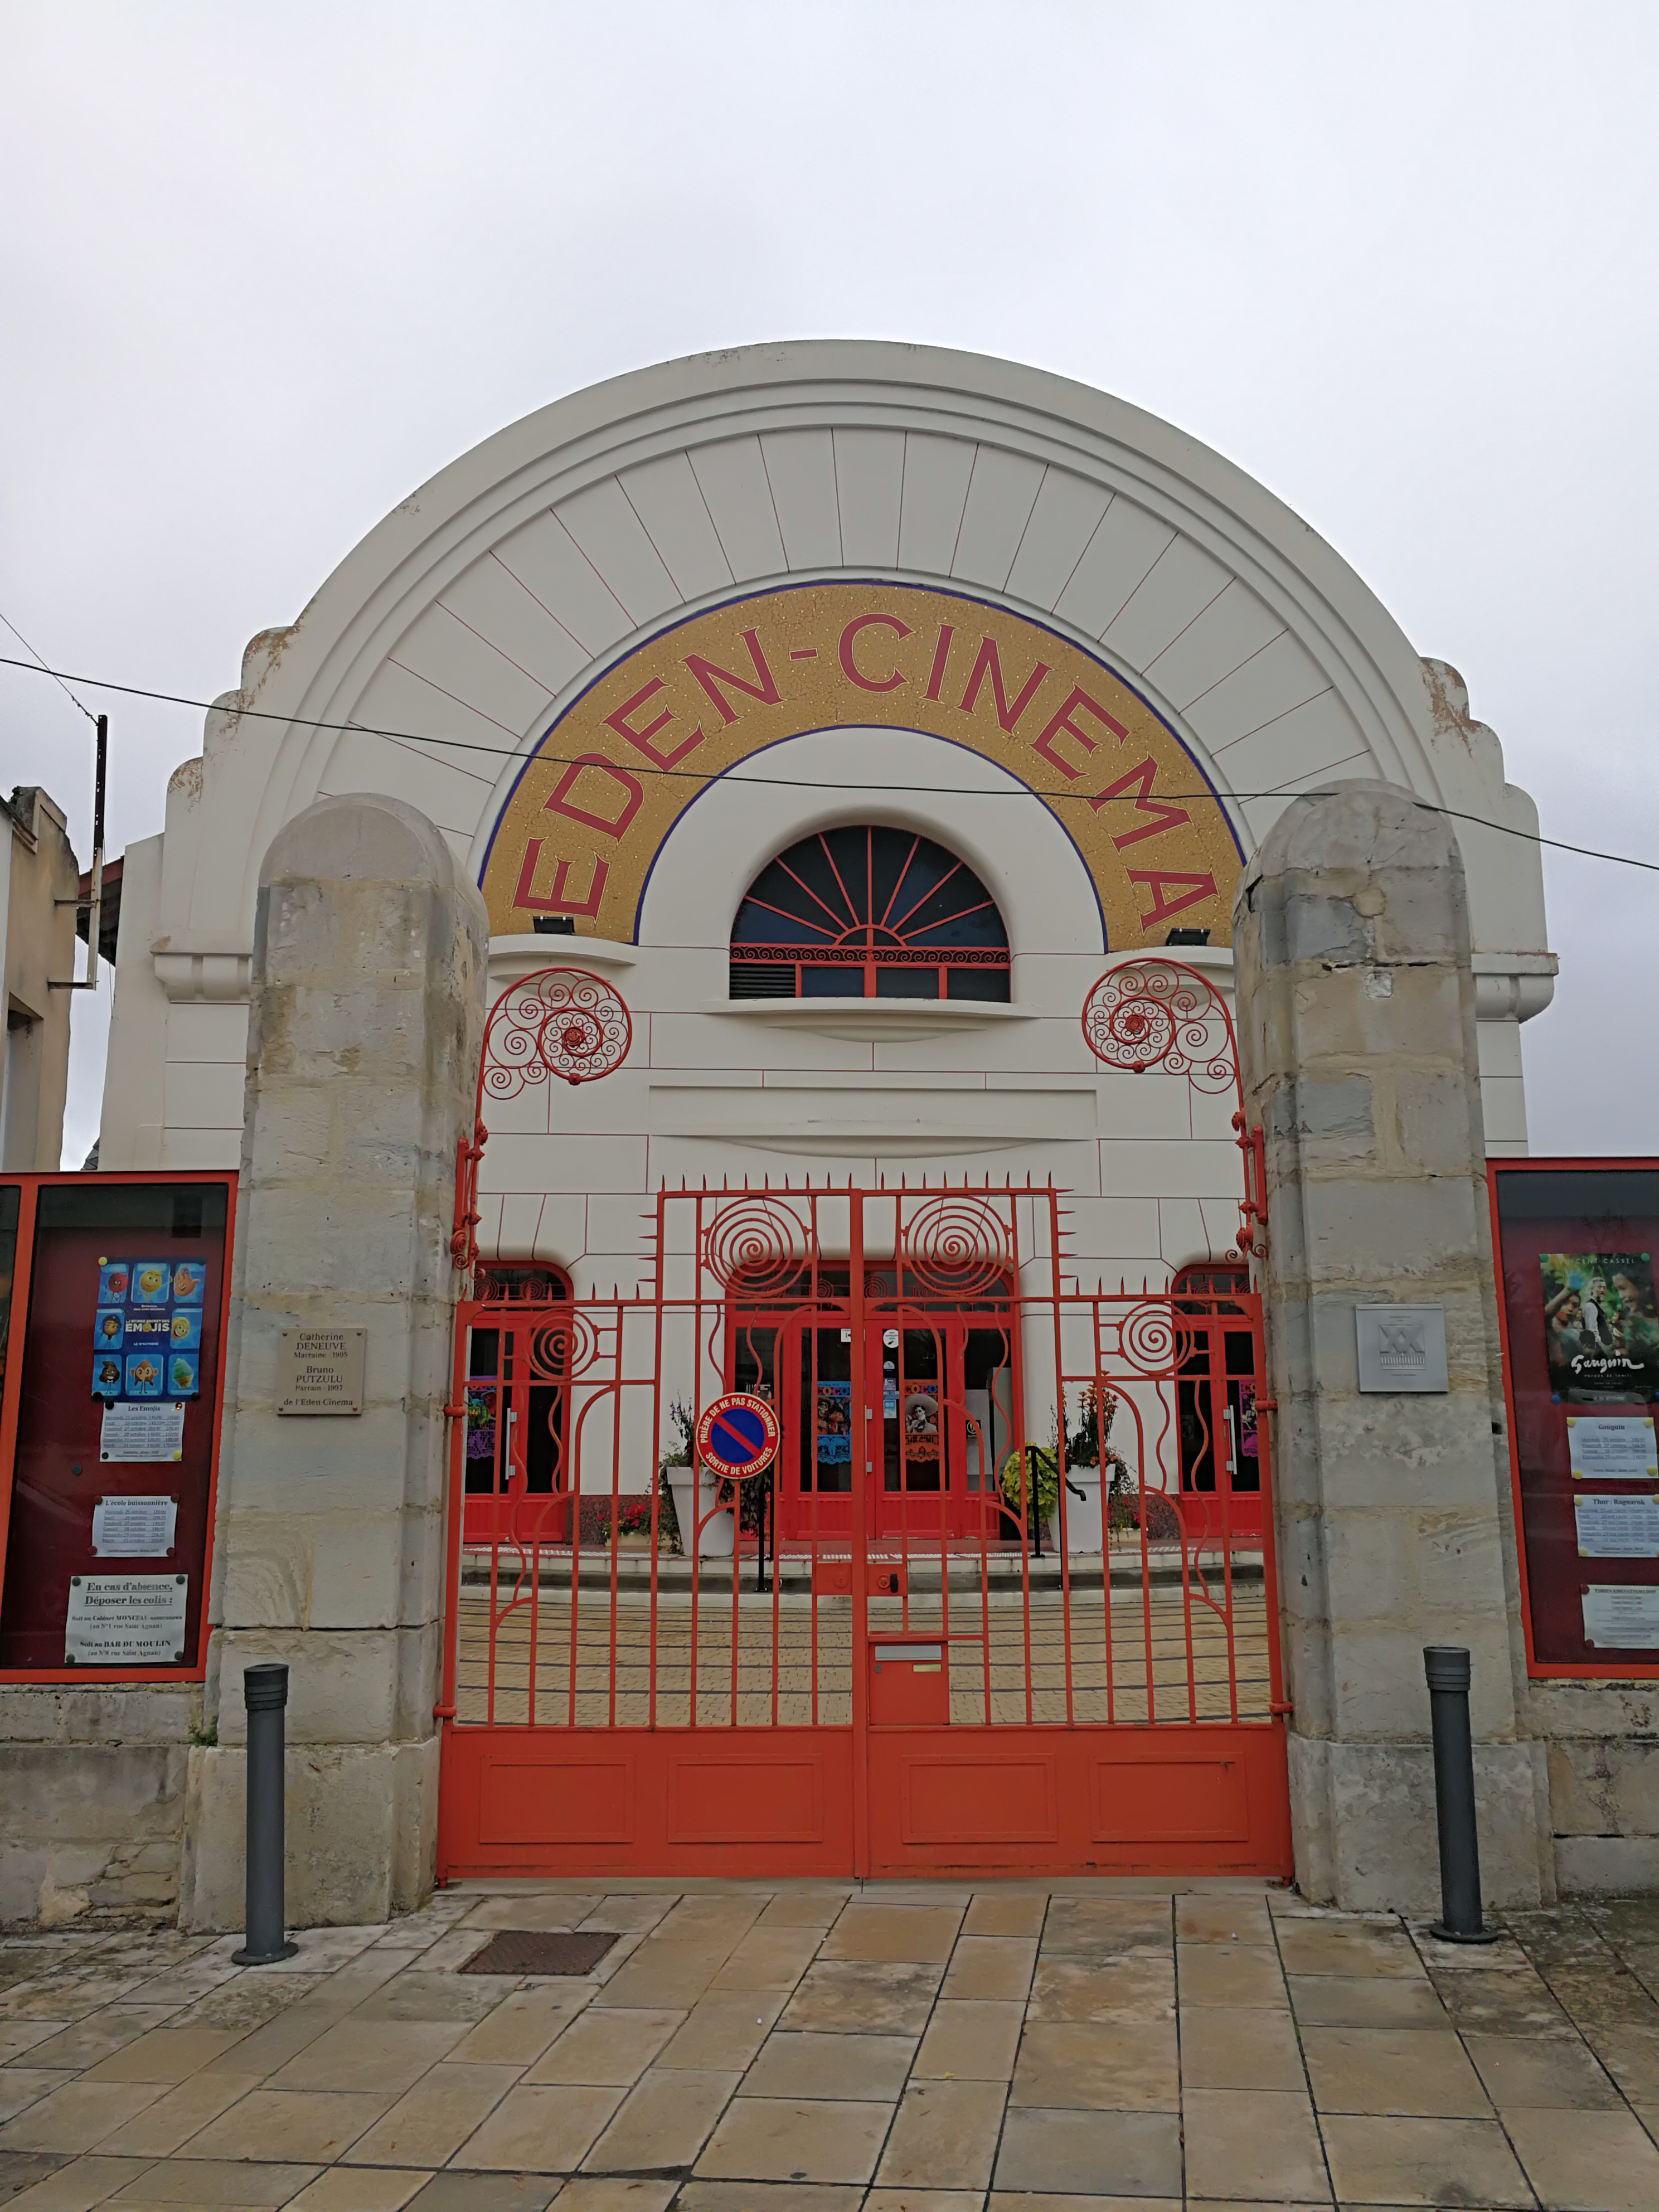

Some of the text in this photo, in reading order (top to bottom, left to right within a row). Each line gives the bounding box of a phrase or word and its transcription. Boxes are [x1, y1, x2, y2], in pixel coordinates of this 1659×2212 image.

[512, 611, 1221, 935] EDEN-CINEMA
[125, 1323, 170, 1332] EMOJIS
[1571, 1350, 1644, 1374] Gauguin
[699, 1397, 775, 1444] PRIÈRE DE NE PAS STATIONNER
[705, 1447, 773, 1475] SORTIE DE VOITURES
[87, 1582, 101, 1591] En
[123, 1582, 173, 1591] d'absence,
[85, 1595, 127, 1605] Déposer
[129, 1595, 141, 1604] les
[143, 1595, 167, 1604] colis
